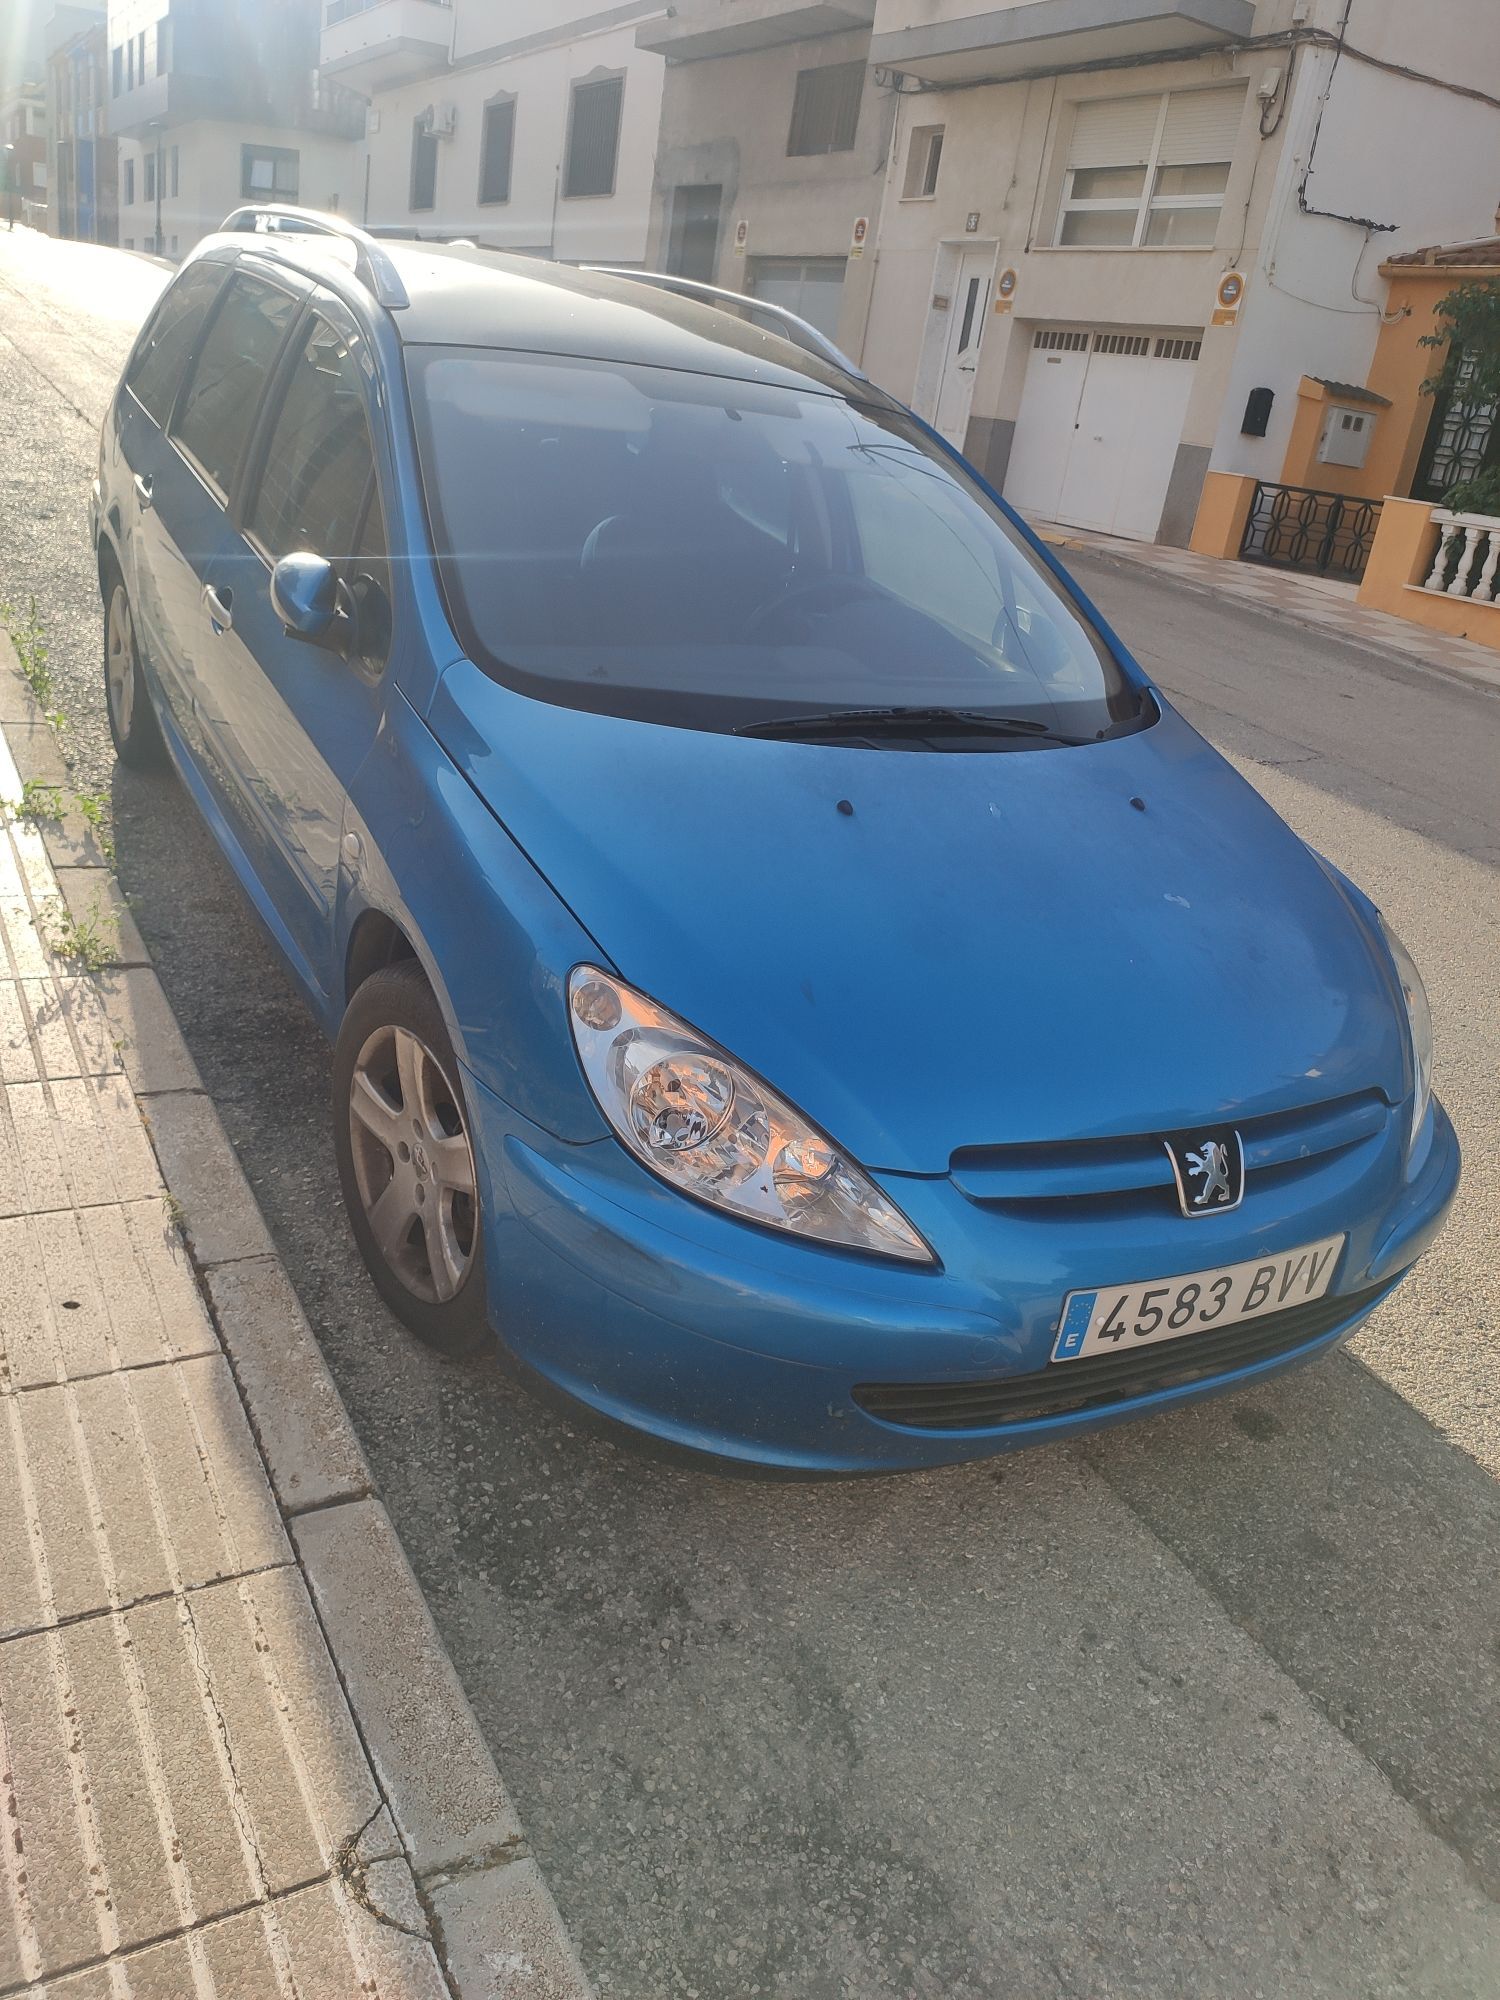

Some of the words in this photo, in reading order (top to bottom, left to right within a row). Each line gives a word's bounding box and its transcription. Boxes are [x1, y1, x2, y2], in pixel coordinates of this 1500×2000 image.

[1098, 1276, 1233, 1342] 4583
[1241, 1247, 1334, 1312] BVV
[1065, 1333, 1079, 1348] E
